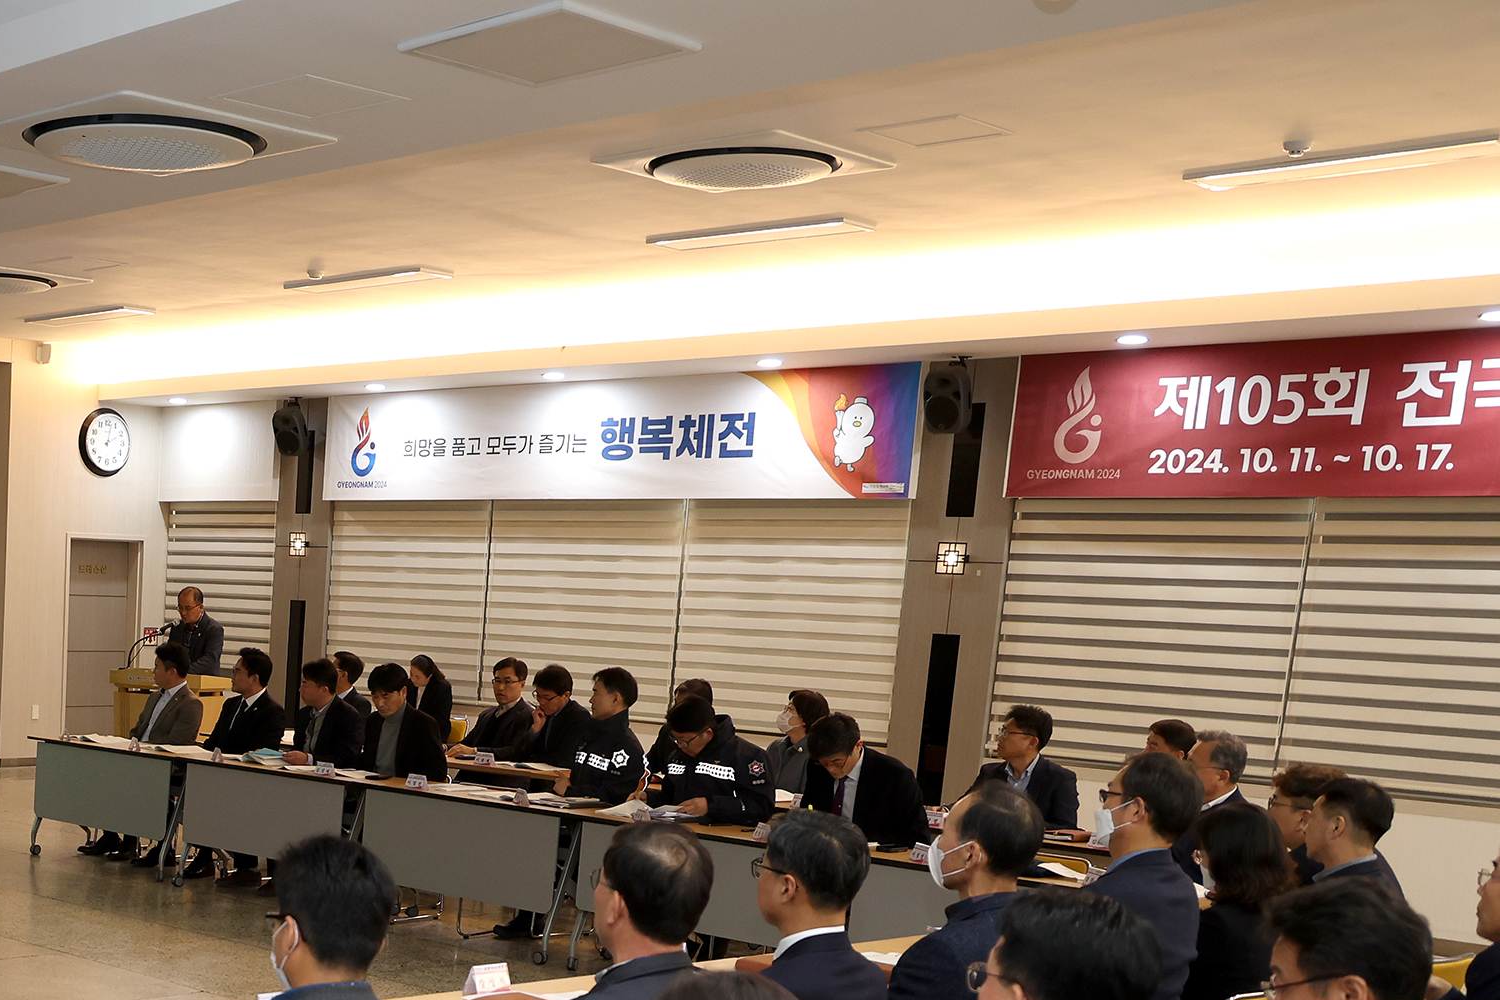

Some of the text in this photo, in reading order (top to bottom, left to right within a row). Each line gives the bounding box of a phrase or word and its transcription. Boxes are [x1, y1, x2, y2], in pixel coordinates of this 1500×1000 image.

[1153, 366, 1370, 430] 제105회
[403, 411, 756, 461] 희망을 품고 모두가 즐기는 행복체전
[1026, 468, 1121, 480] GYEONGNAM 2024
[1148, 449, 1229, 474] 2024.
[1239, 447, 1278, 473] 10.
[1290, 446, 1323, 472] 11.
[1361, 444, 1403, 471] 10.
[1415, 444, 1455, 470] 17.
[337, 480, 387, 489] GYEONGNAM 2024
